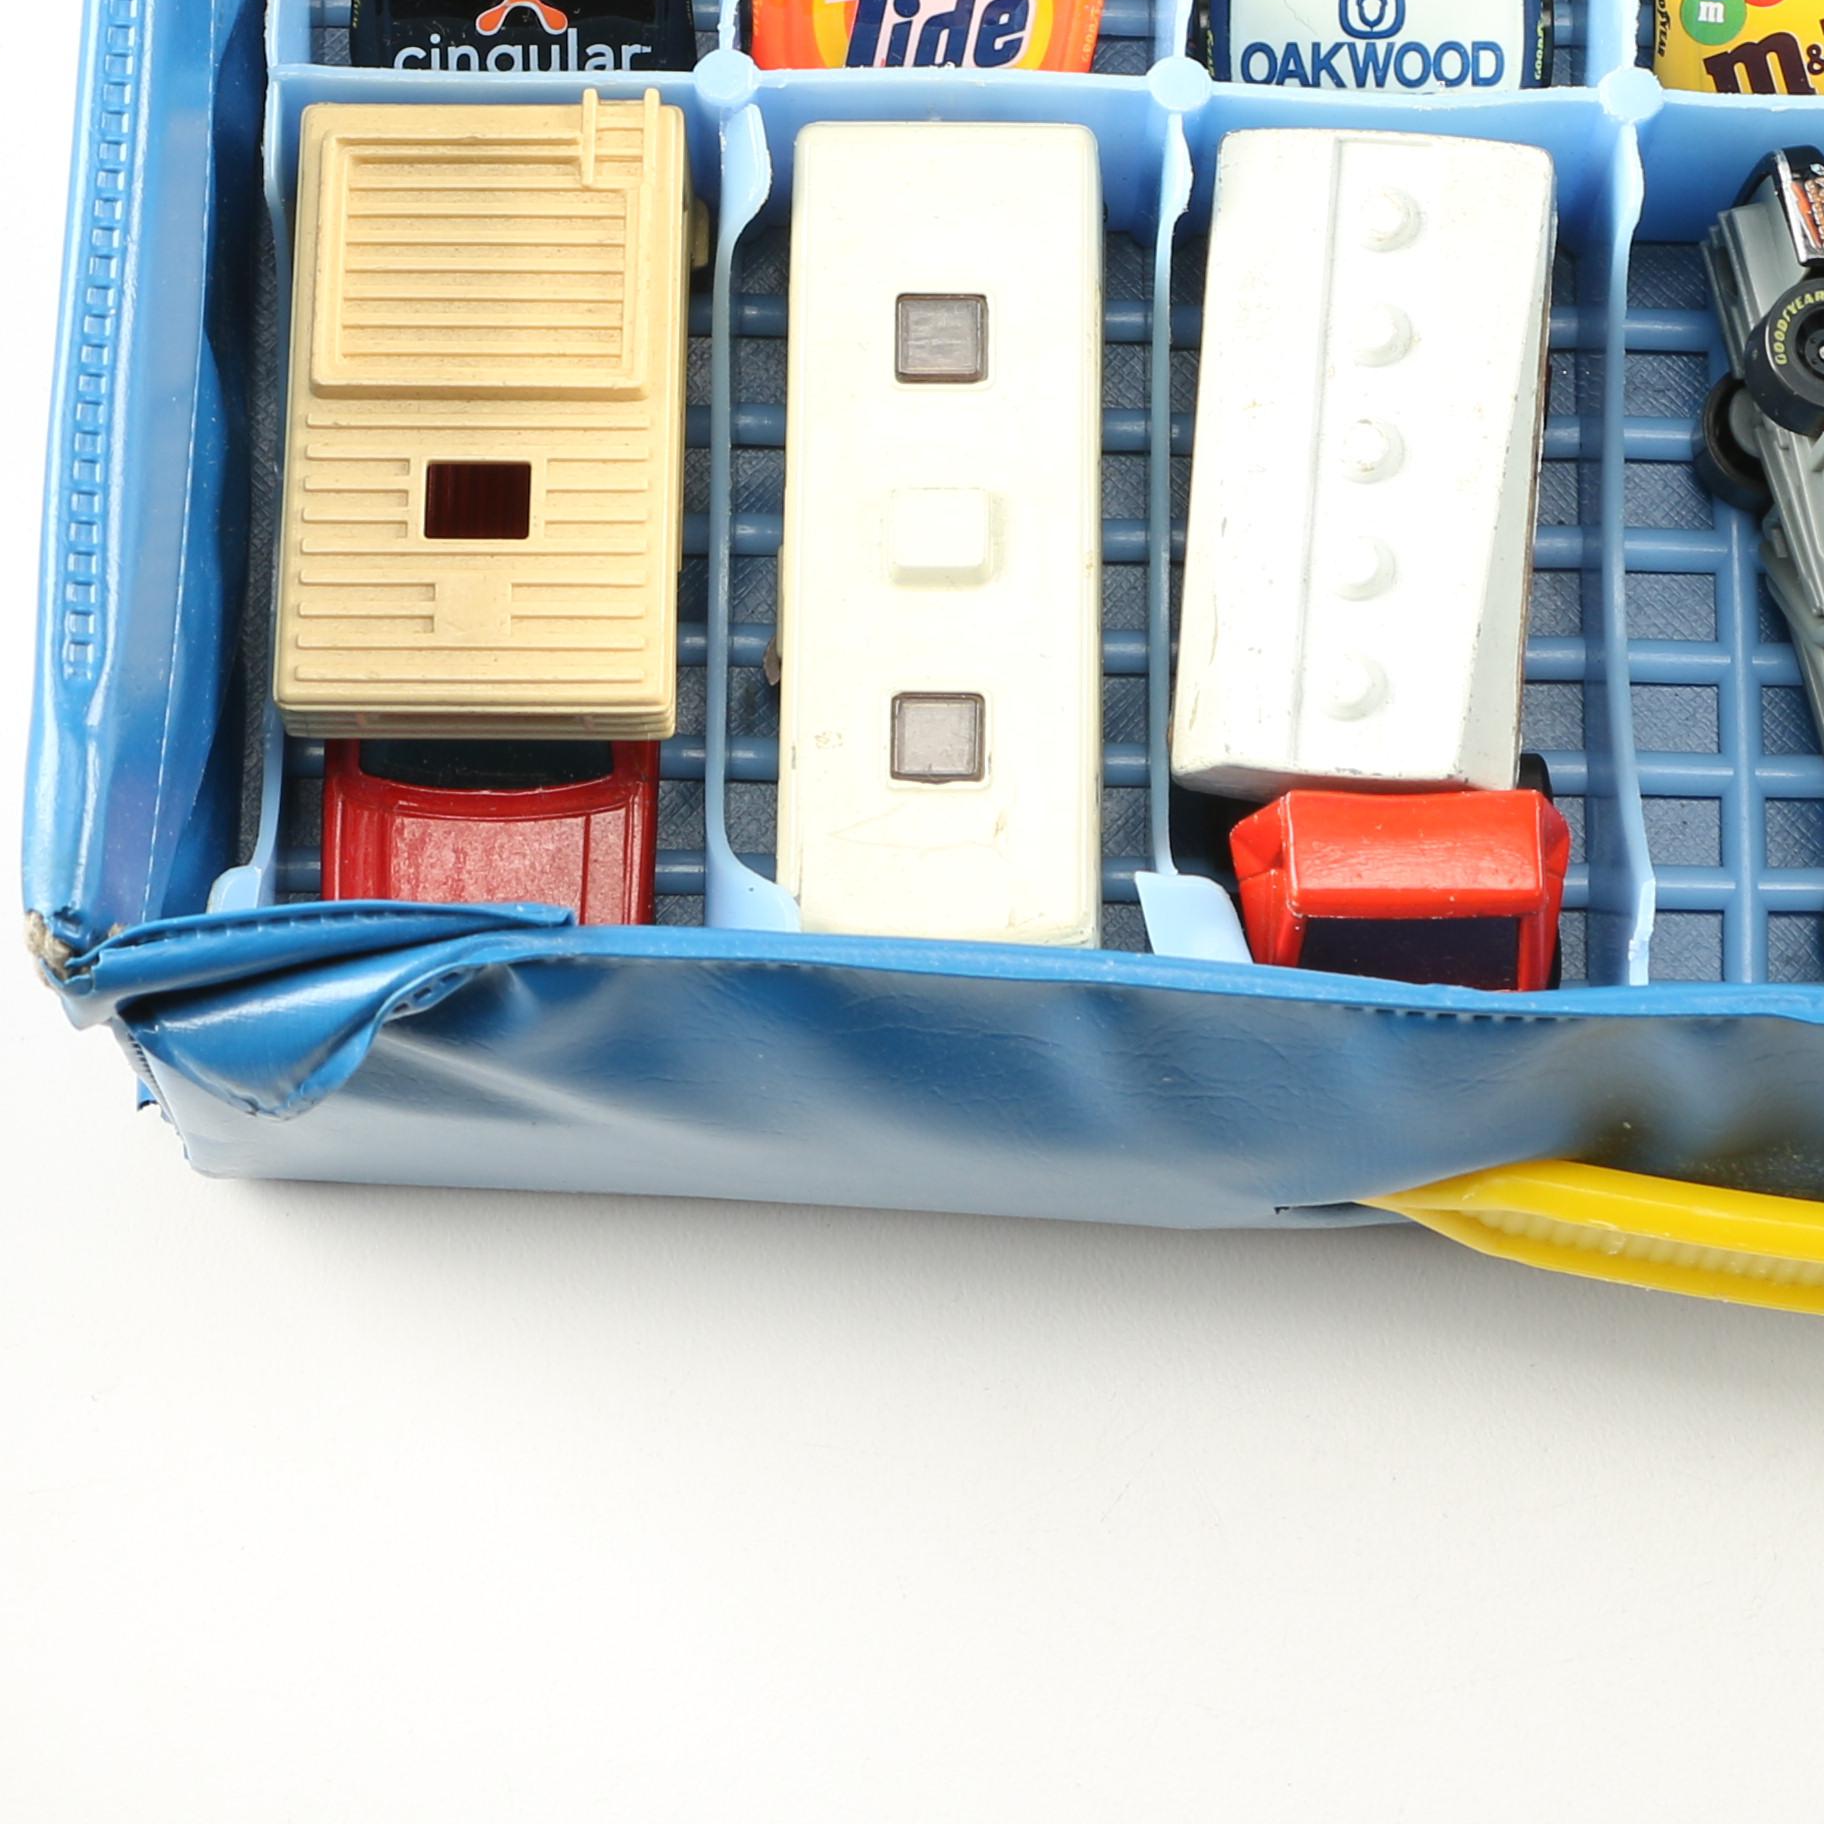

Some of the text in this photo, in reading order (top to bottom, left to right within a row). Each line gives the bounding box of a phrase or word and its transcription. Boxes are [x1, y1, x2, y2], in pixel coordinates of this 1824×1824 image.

[1696, 0, 1725, 24] m
[393, 28, 653, 73] cingular
[1240, 40, 1506, 89] OAKWOOD
